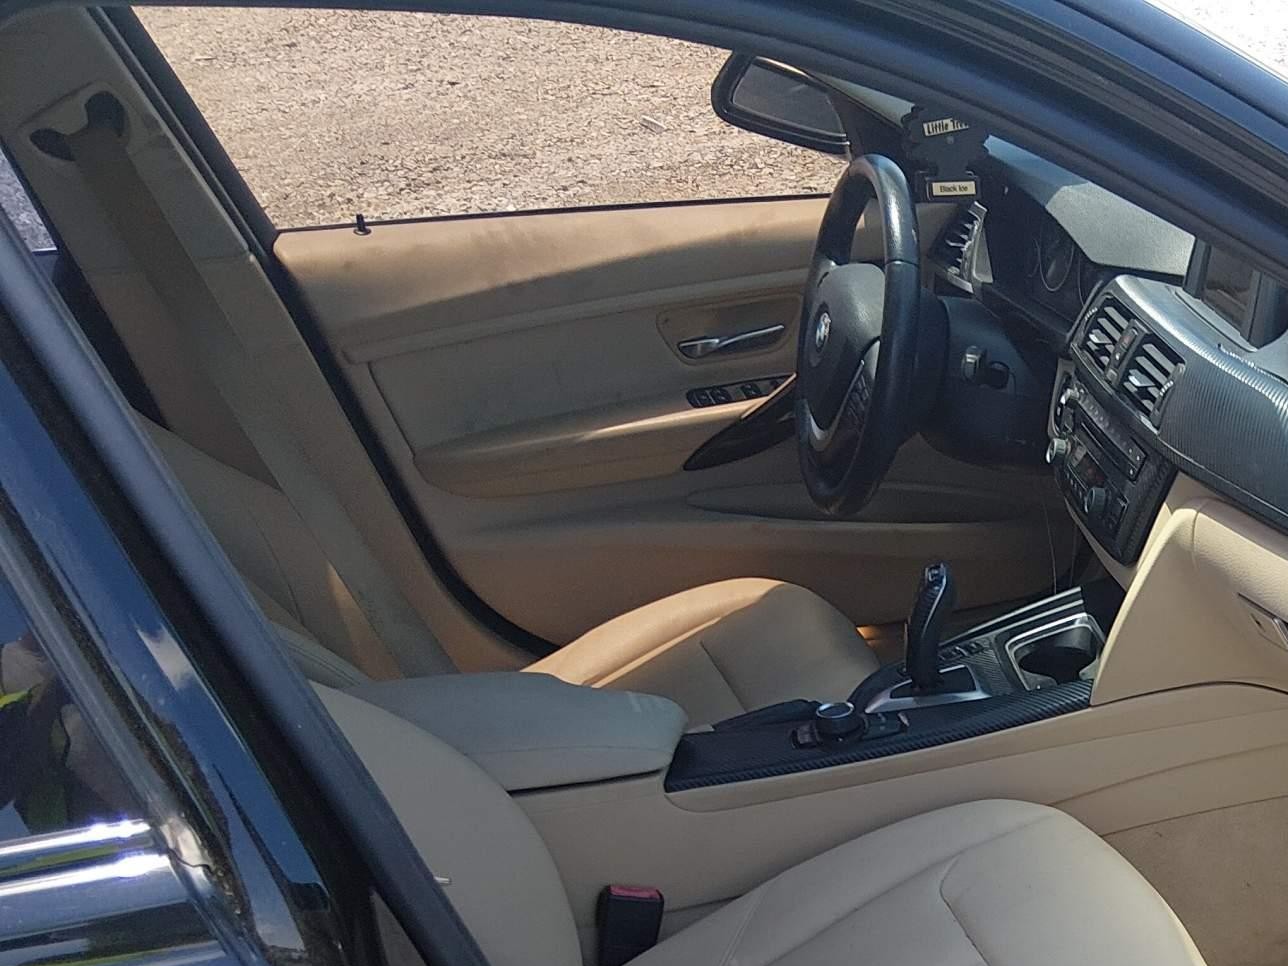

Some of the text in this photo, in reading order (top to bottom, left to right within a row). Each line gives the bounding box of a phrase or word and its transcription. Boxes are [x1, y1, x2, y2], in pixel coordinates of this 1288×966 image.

[927, 121, 949, 135] Little
[939, 184, 968, 193] Black Ice
